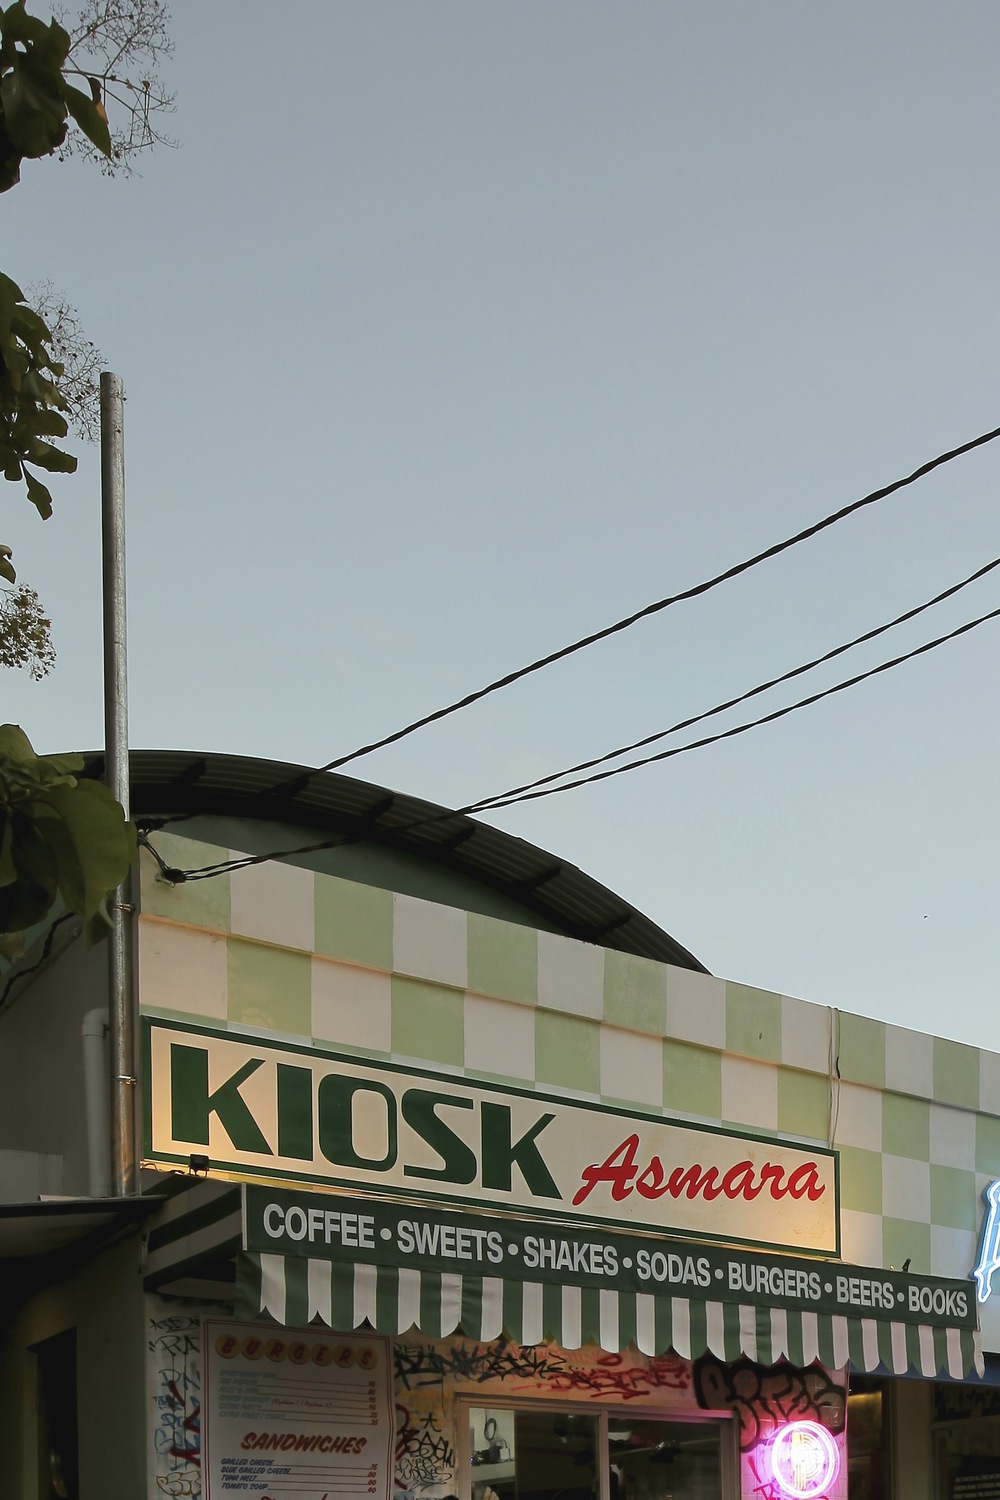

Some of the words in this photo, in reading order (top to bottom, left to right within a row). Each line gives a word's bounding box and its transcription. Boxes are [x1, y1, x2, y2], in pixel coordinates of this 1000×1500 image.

[170, 1043, 562, 1200] KIOSK
[572, 1133, 826, 1206] Asmara
[263, 1204, 375, 1250] COFFEE
[397, 1220, 504, 1264] SWEETS
[523, 1236, 619, 1277] SHAKES
[636, 1249, 711, 1288] SODAS
[728, 1262, 822, 1301] BURGERS
[836, 1277, 895, 1309] BEERS
[908, 1285, 968, 1318] BOOKS
[220, 1337, 374, 1366] BURGERS
[241, 1432, 367, 1454] SANDWICHES
[221, 1458, 248, 1466] GRILLED
[221, 1482, 248, 1490] TOMATO
